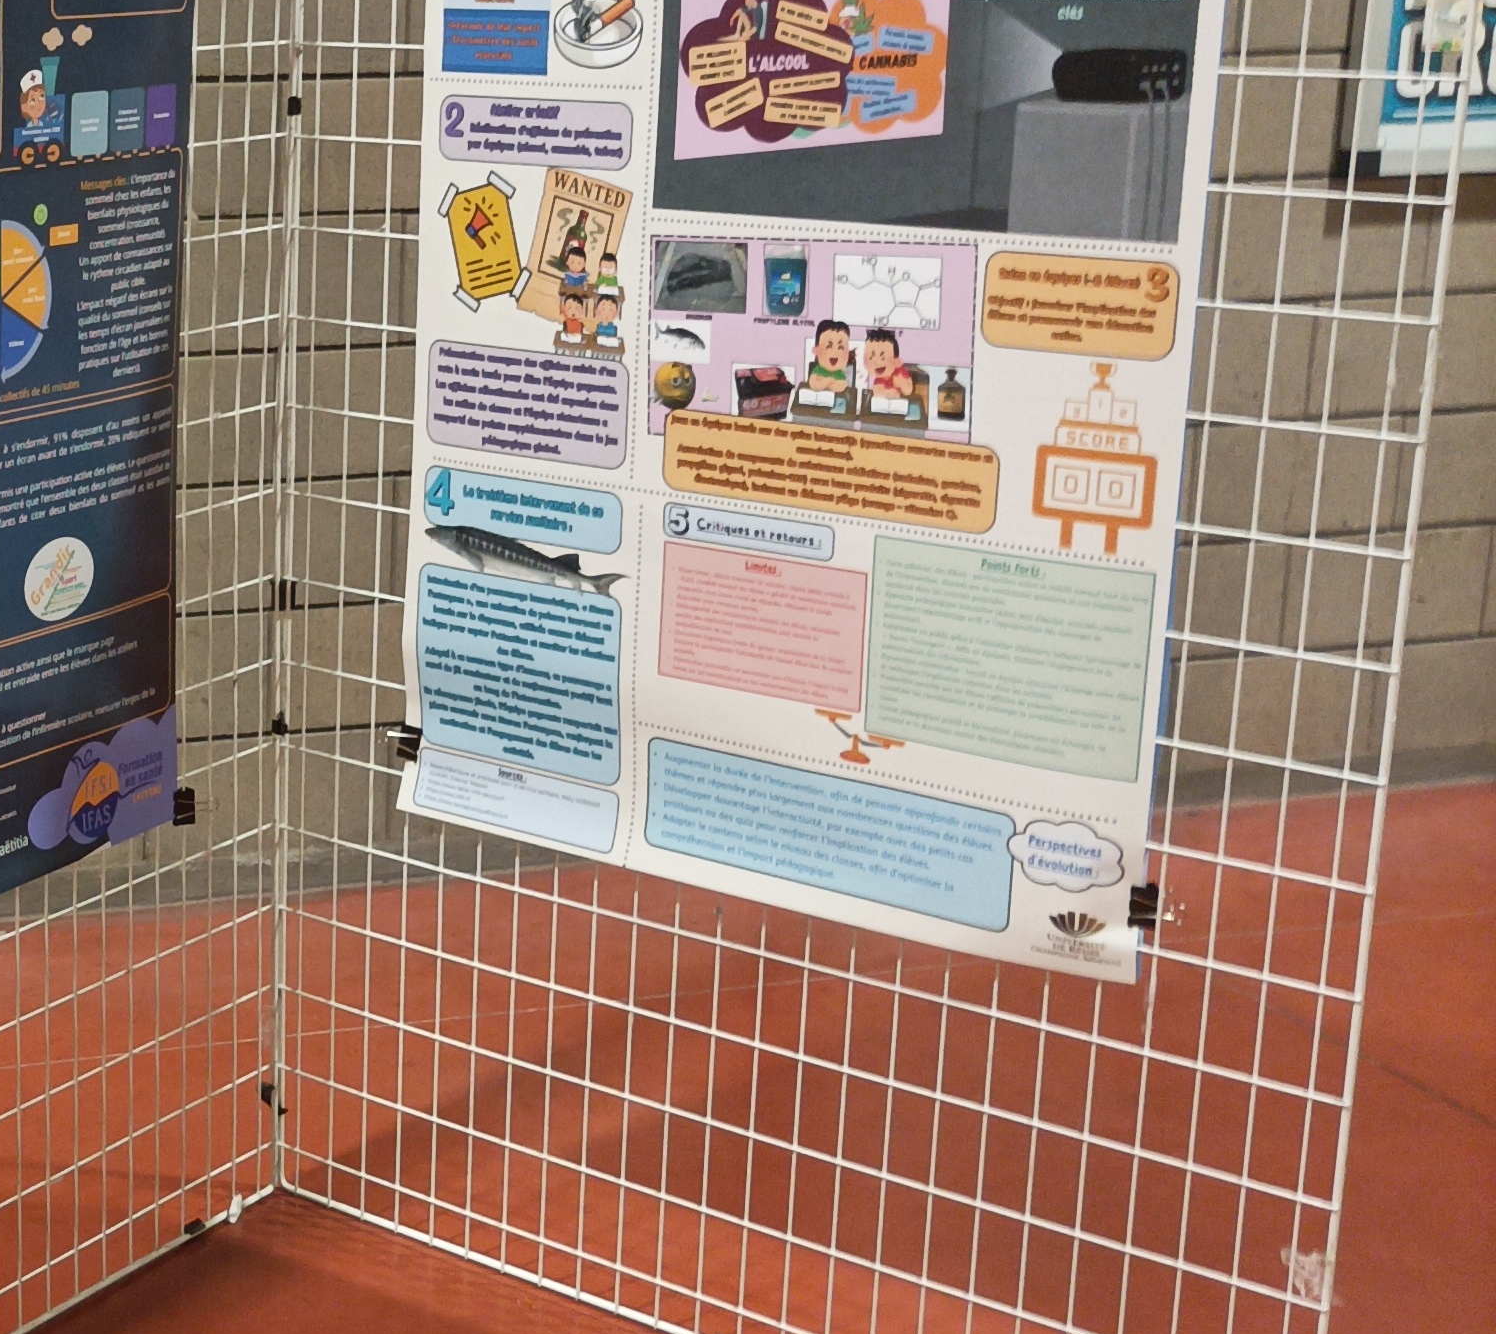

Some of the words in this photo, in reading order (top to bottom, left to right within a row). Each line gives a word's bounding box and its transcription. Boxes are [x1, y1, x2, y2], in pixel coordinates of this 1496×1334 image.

[748, 52, 810, 73] L'ALCOOL
[444, 101, 465, 138] 2
[553, 170, 626, 208] WANTED
[1146, 266, 1171, 302] 3
[1064, 429, 1131, 451] SCORE
[426, 468, 455, 517] 4
[667, 509, 691, 536] 5
[695, 516, 751, 537] Critiques
[753, 523, 767, 536] et
[769, 527, 815, 548] retours
[80, 805, 112, 830] IFAS
[1027, 833, 1102, 860] Perspectives
